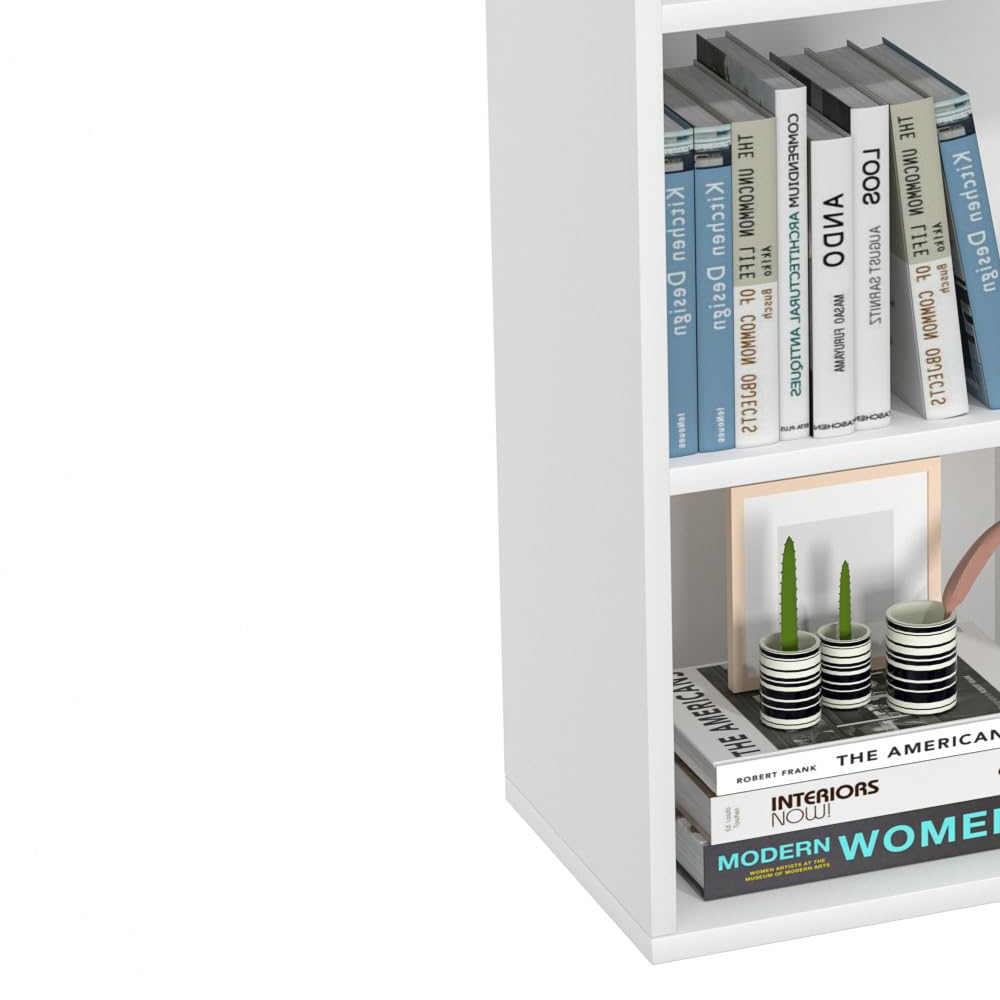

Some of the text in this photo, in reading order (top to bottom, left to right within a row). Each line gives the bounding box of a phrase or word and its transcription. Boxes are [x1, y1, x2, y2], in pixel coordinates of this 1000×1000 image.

[718, 733, 760, 757] THE
[836, 750, 878, 766] THE
[736, 765, 817, 784] ROBERT FRANK
[771, 779, 880, 811] INTERIORS
[771, 803, 831, 827] NOW!
[718, 837, 830, 871] MODERN
[744, 873, 773, 882] MUSEUM
[784, 866, 813, 875] MODERN
[813, 862, 831, 870] ARTS
[749, 867, 775, 876] WOMEN
[776, 862, 802, 871] ARTISTS
[813, 857, 826, 865] THE
